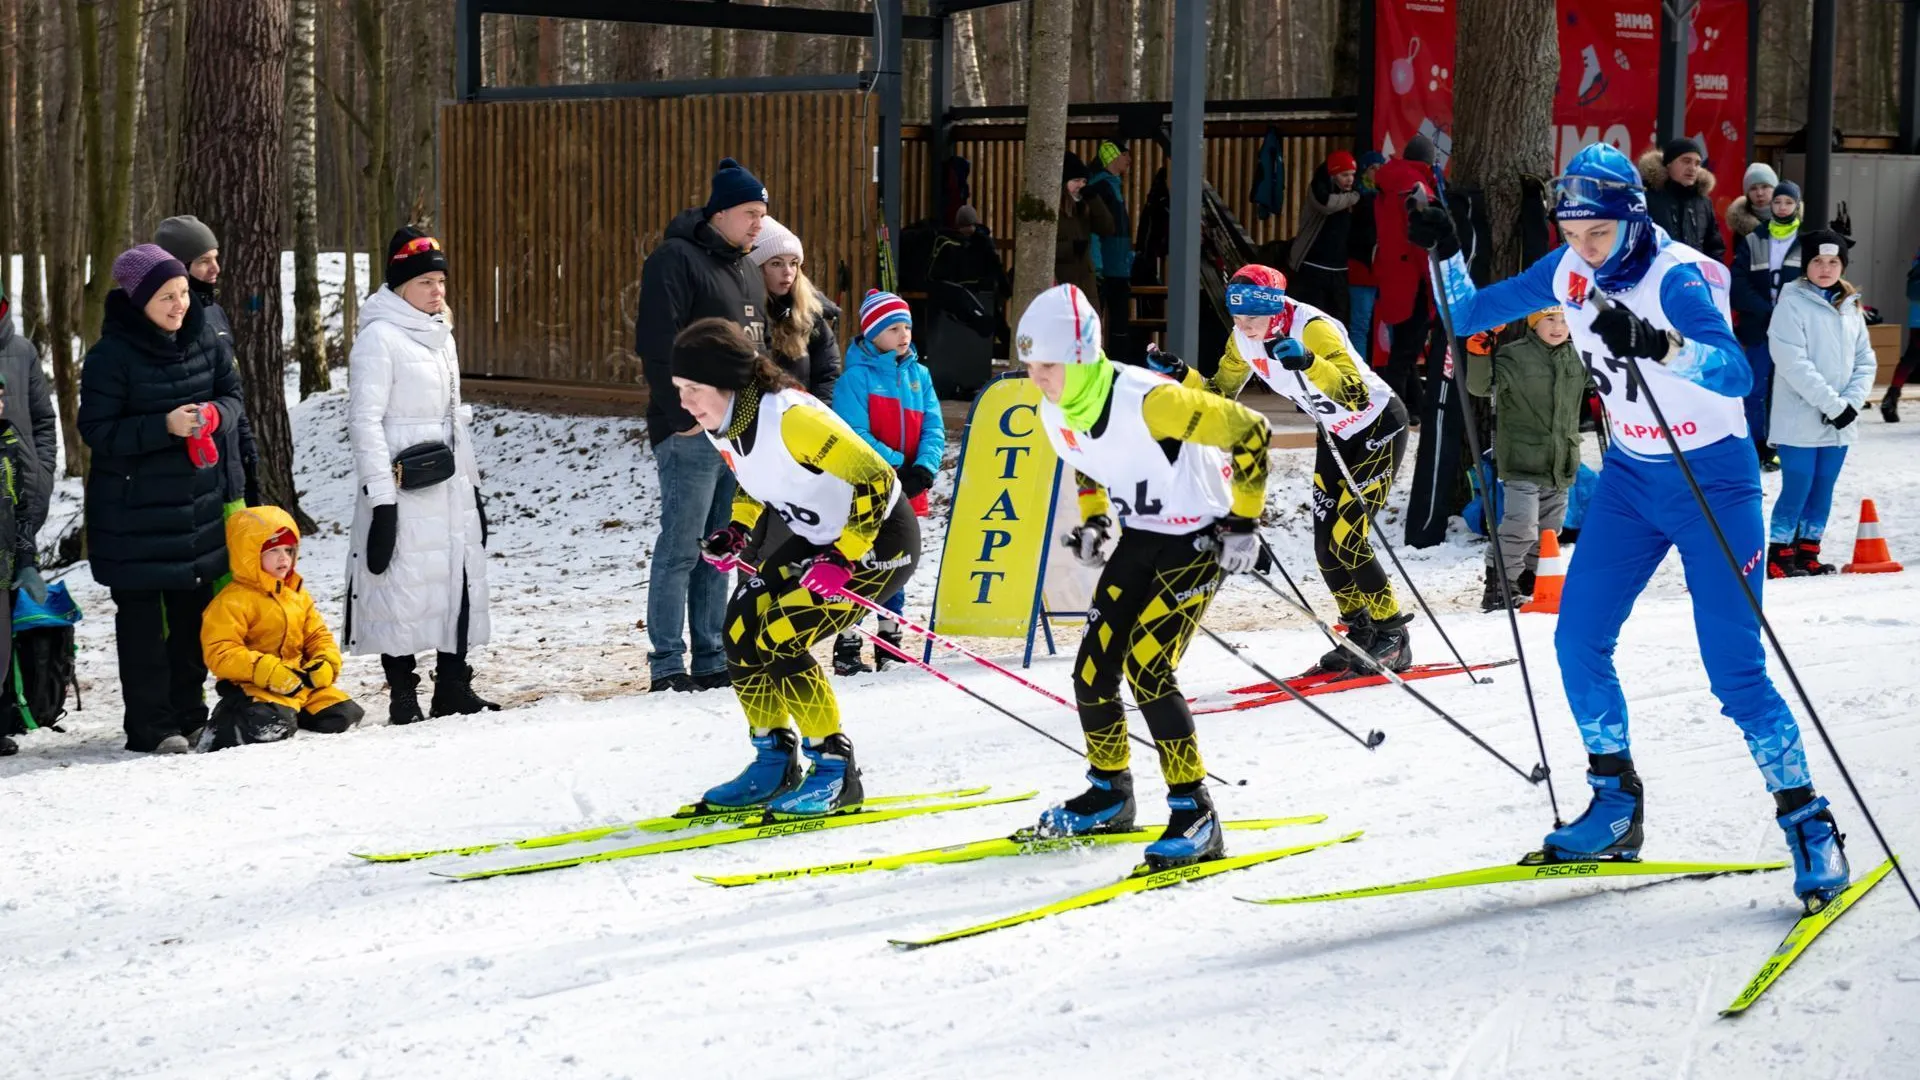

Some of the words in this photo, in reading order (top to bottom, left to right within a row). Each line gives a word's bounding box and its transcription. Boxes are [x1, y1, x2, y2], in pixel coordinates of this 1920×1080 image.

[970, 404, 1037, 604] СТАРТ
[757, 819, 826, 838] FISCHER
[1146, 866, 1201, 887] FISCHER
[1535, 864, 1599, 877] FISCHER
